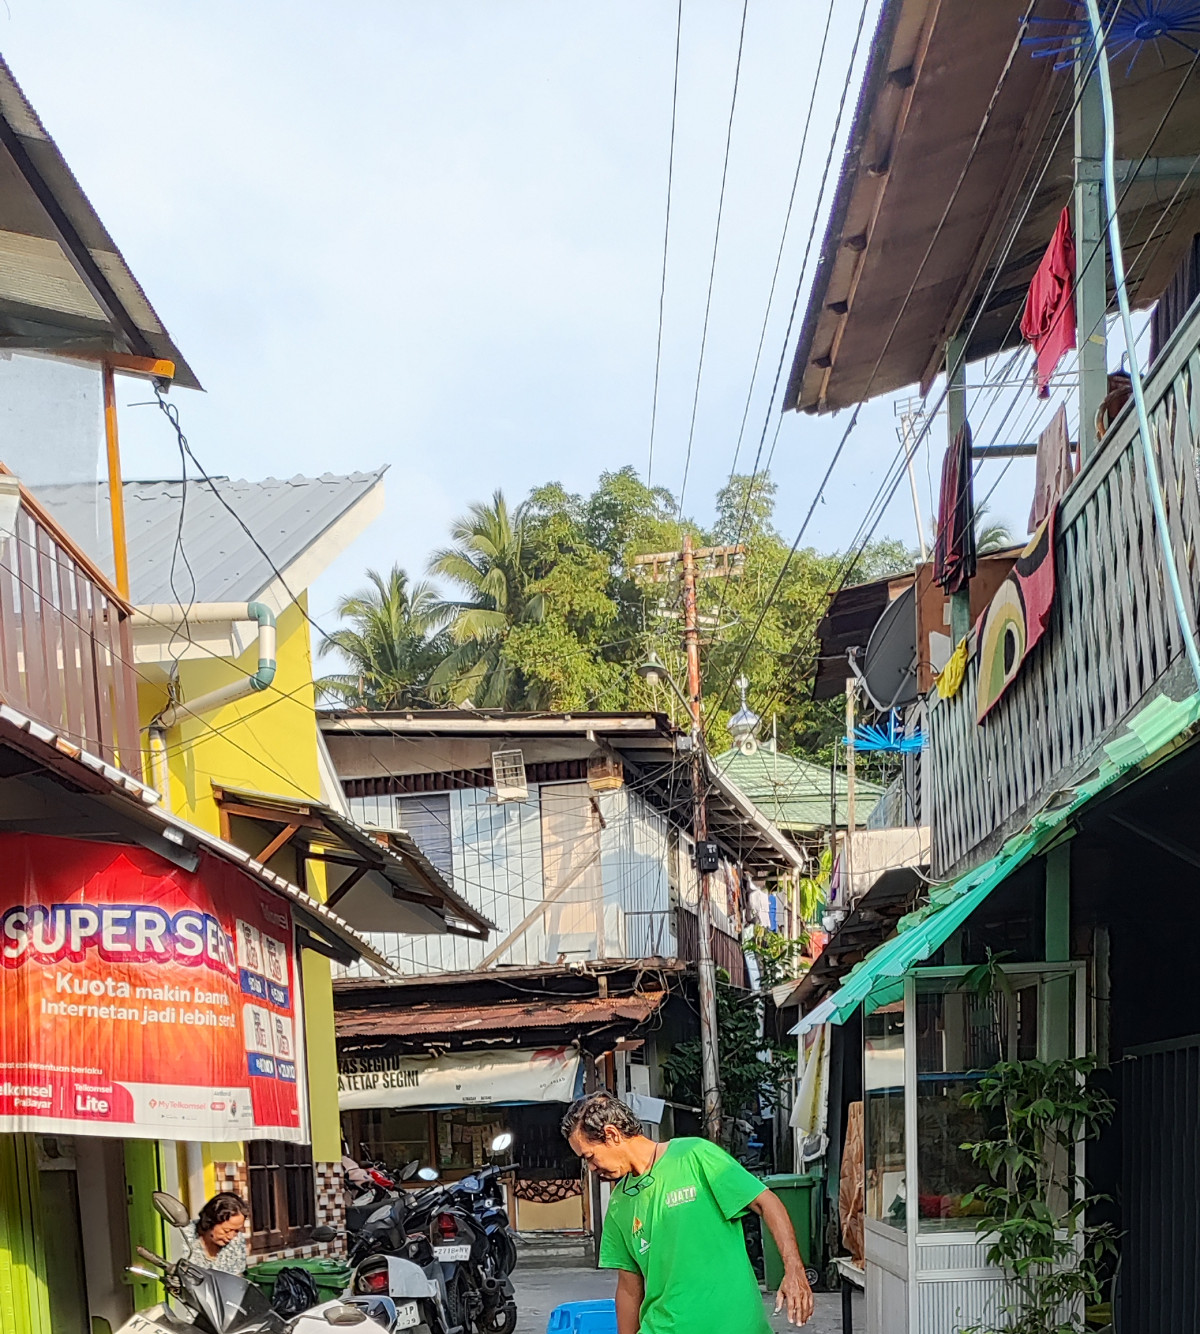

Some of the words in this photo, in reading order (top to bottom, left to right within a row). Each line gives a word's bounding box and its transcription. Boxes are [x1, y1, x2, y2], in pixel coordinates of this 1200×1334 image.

[2, 906, 168, 961] SUPER
[56, 971, 130, 998] Kuota
[136, 985, 191, 1003] makin
[41, 998, 139, 1021] Internetan
[141, 1004, 176, 1026] jadi
[179, 1007, 217, 1027] lebih
[71, 1065, 103, 1075] berlaku
[360, 1055, 400, 1073] SEGITU
[74, 1083, 113, 1094] Telkomsel
[346, 1073, 379, 1091] TETAP
[382, 1070, 419, 1089] SEGINI
[76, 1094, 109, 1113] Lite
[130, 1317, 151, 1332] KT
